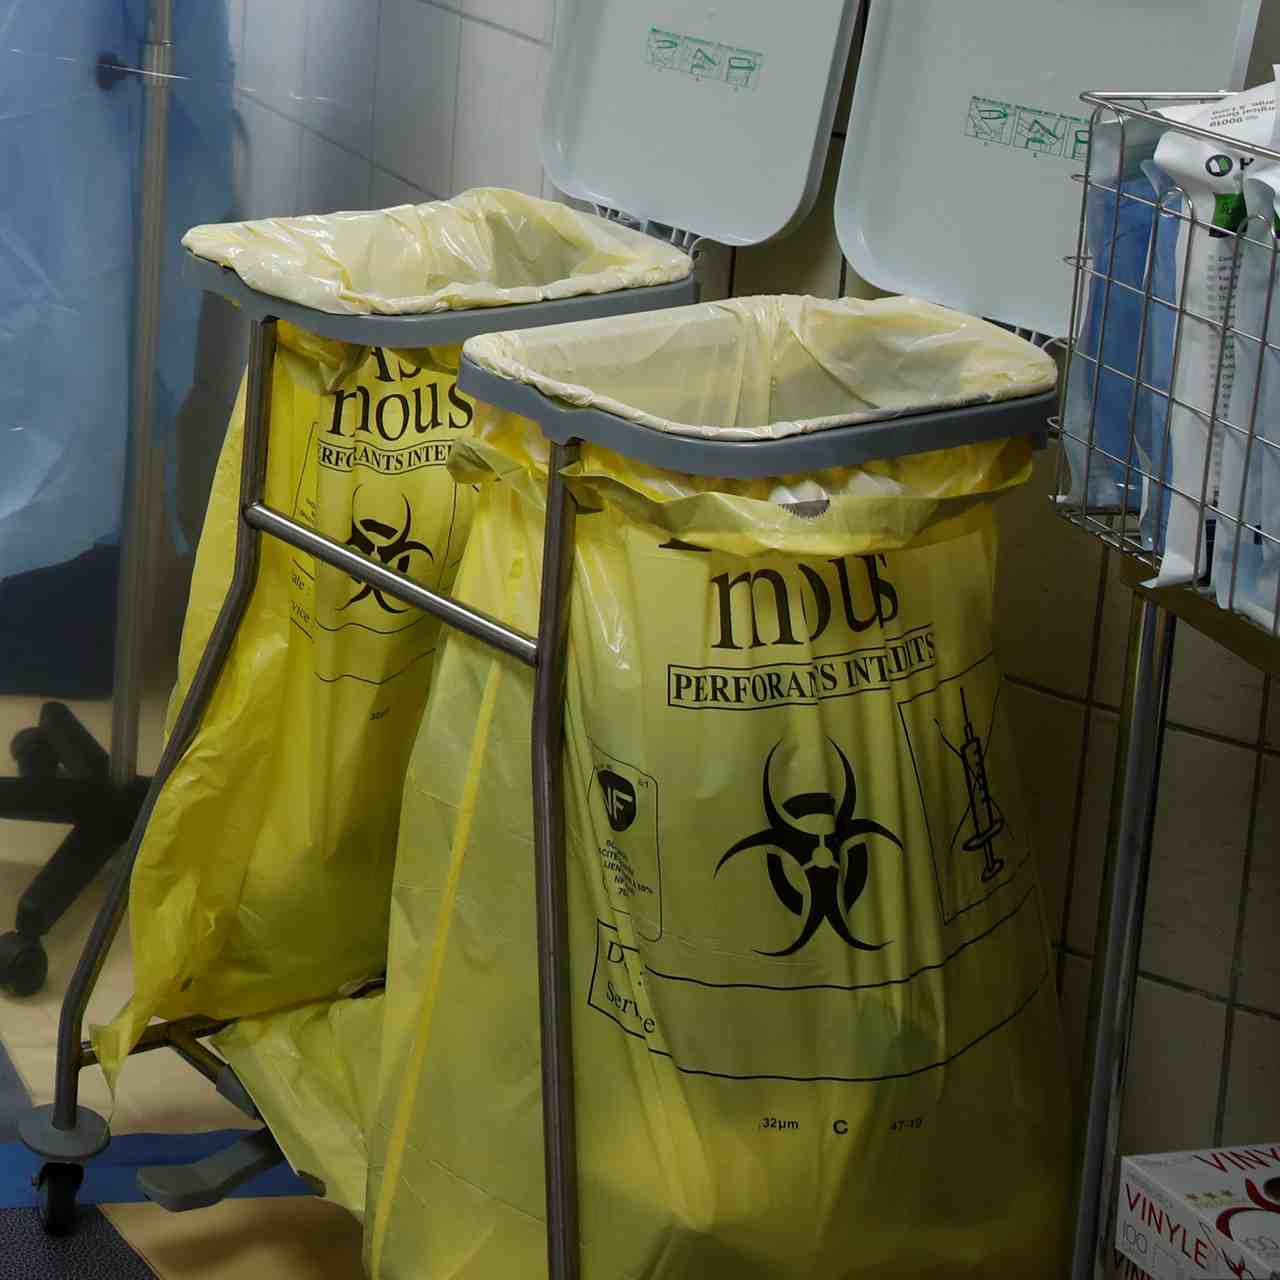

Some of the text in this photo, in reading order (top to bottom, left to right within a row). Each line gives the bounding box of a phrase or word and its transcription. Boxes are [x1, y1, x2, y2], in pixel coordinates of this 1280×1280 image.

[326, 382, 474, 441] nous
[321, 447, 403, 471] RFANTS
[672, 632, 935, 705] PERFORAS INTDITS
[832, 1119, 849, 1135] C
[1192, 1147, 1280, 1173] VINY
[1125, 1183, 1208, 1270] VINYLE
